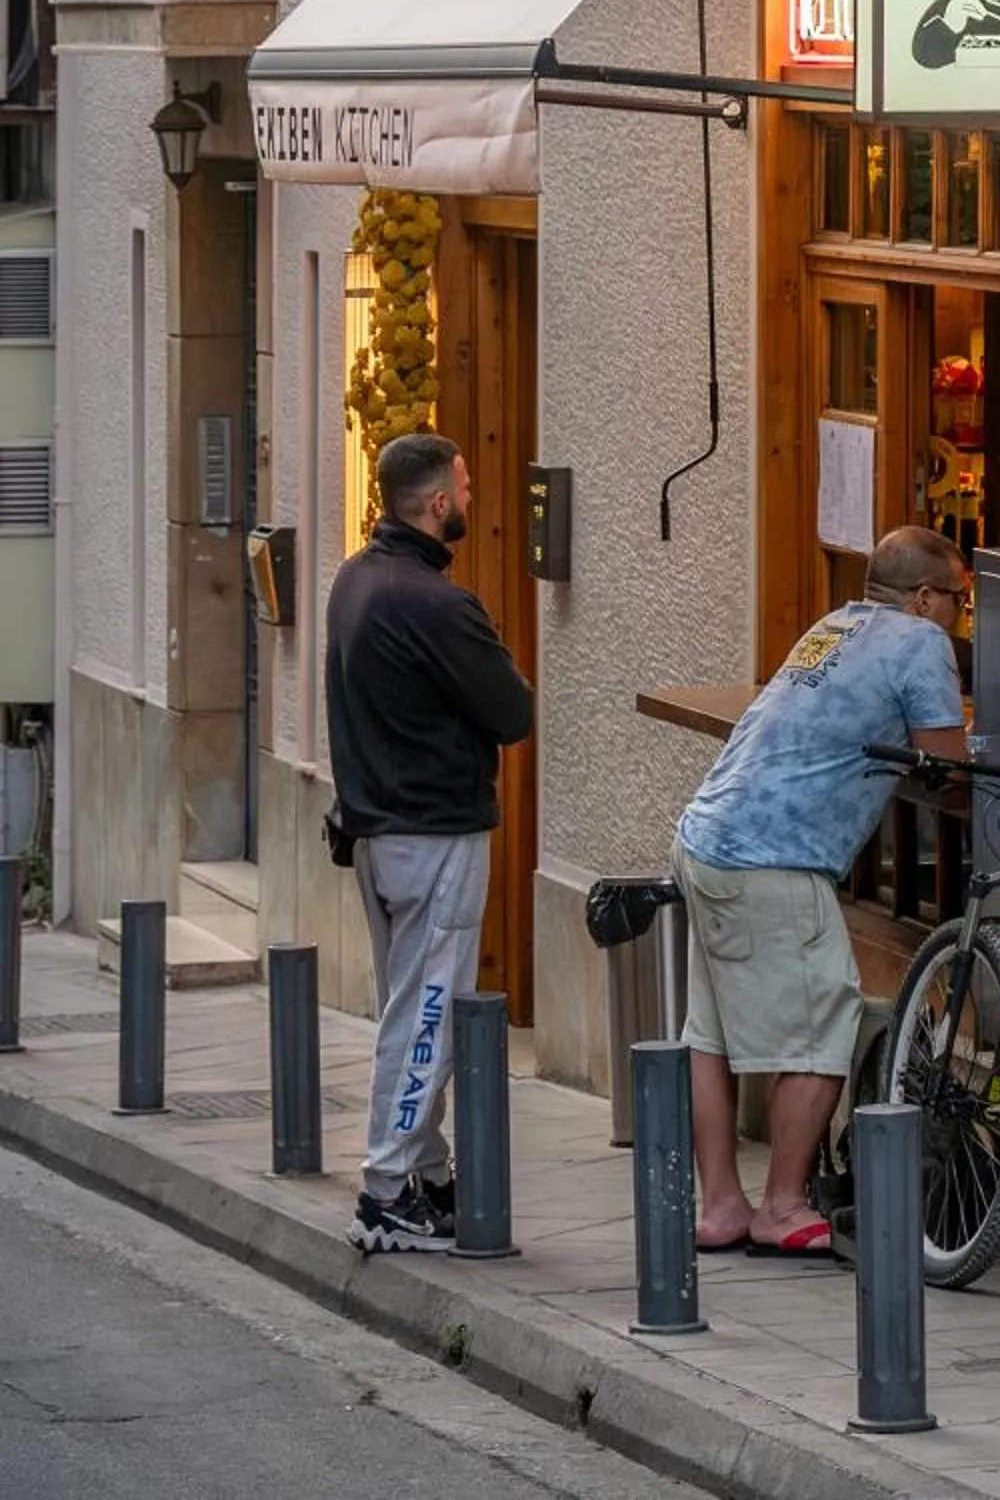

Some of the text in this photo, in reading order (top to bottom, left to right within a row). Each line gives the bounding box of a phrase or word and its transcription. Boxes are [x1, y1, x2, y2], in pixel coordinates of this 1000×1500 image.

[256, 106, 415, 168] EKIBEN KITCHEN
[393, 984, 444, 1131] NIKE AIR
